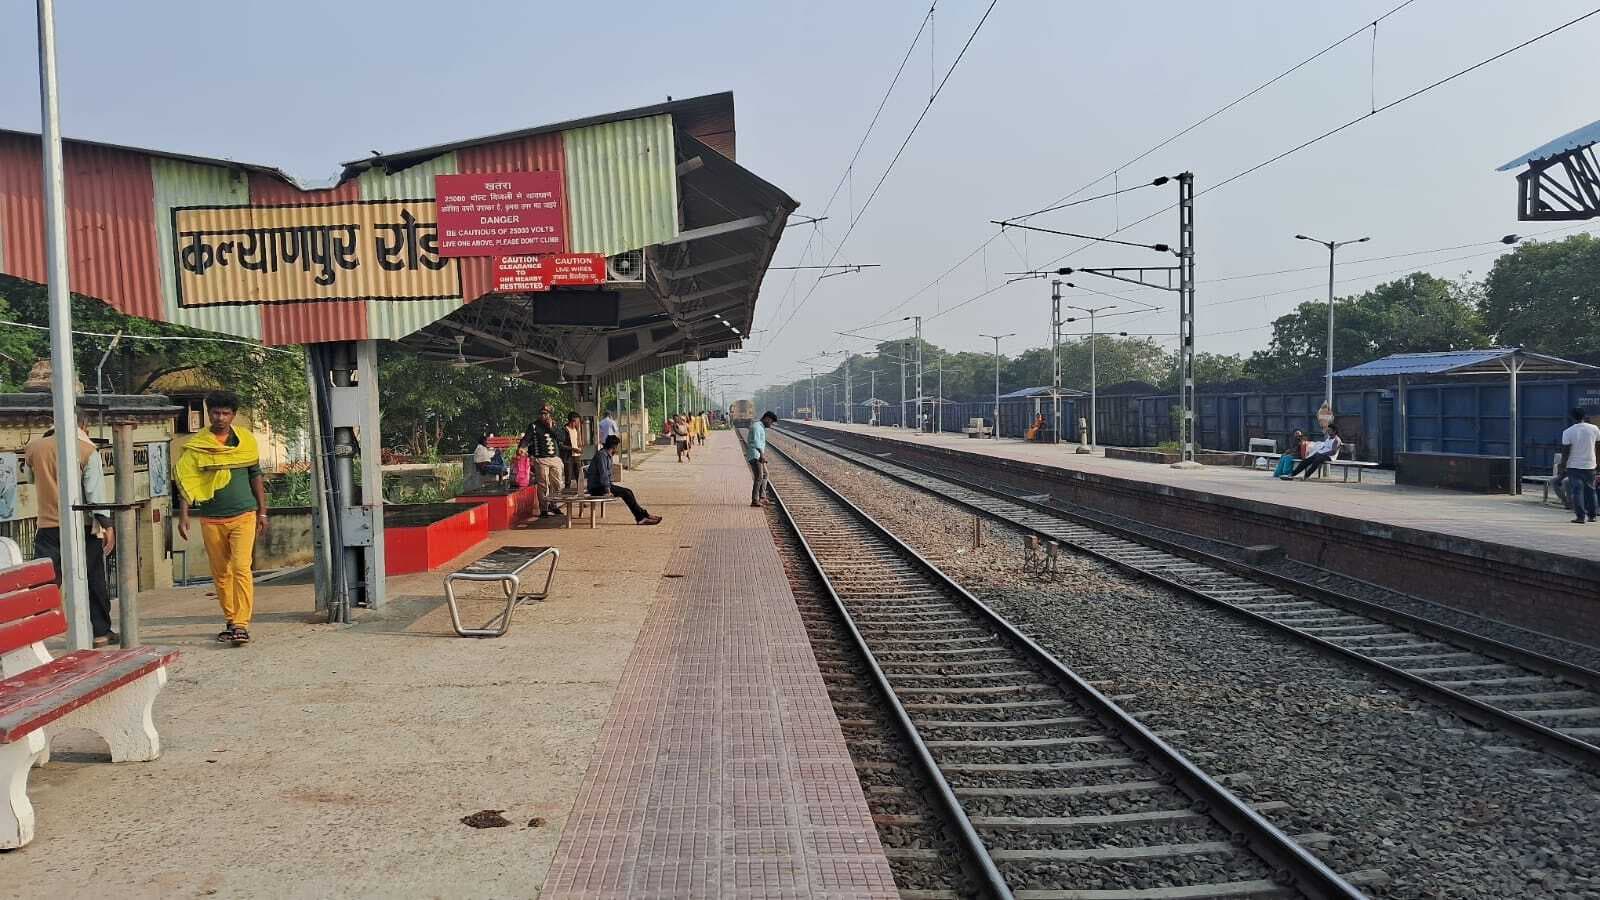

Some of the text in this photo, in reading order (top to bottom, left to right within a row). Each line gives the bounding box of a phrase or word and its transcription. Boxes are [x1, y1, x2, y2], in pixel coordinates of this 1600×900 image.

[485, 182, 512, 190] खतरा
[480, 215, 520, 225] DANGER
[179, 208, 448, 286] कल्याणपुर रोड
[500, 282, 544, 290] RESTRICTED
